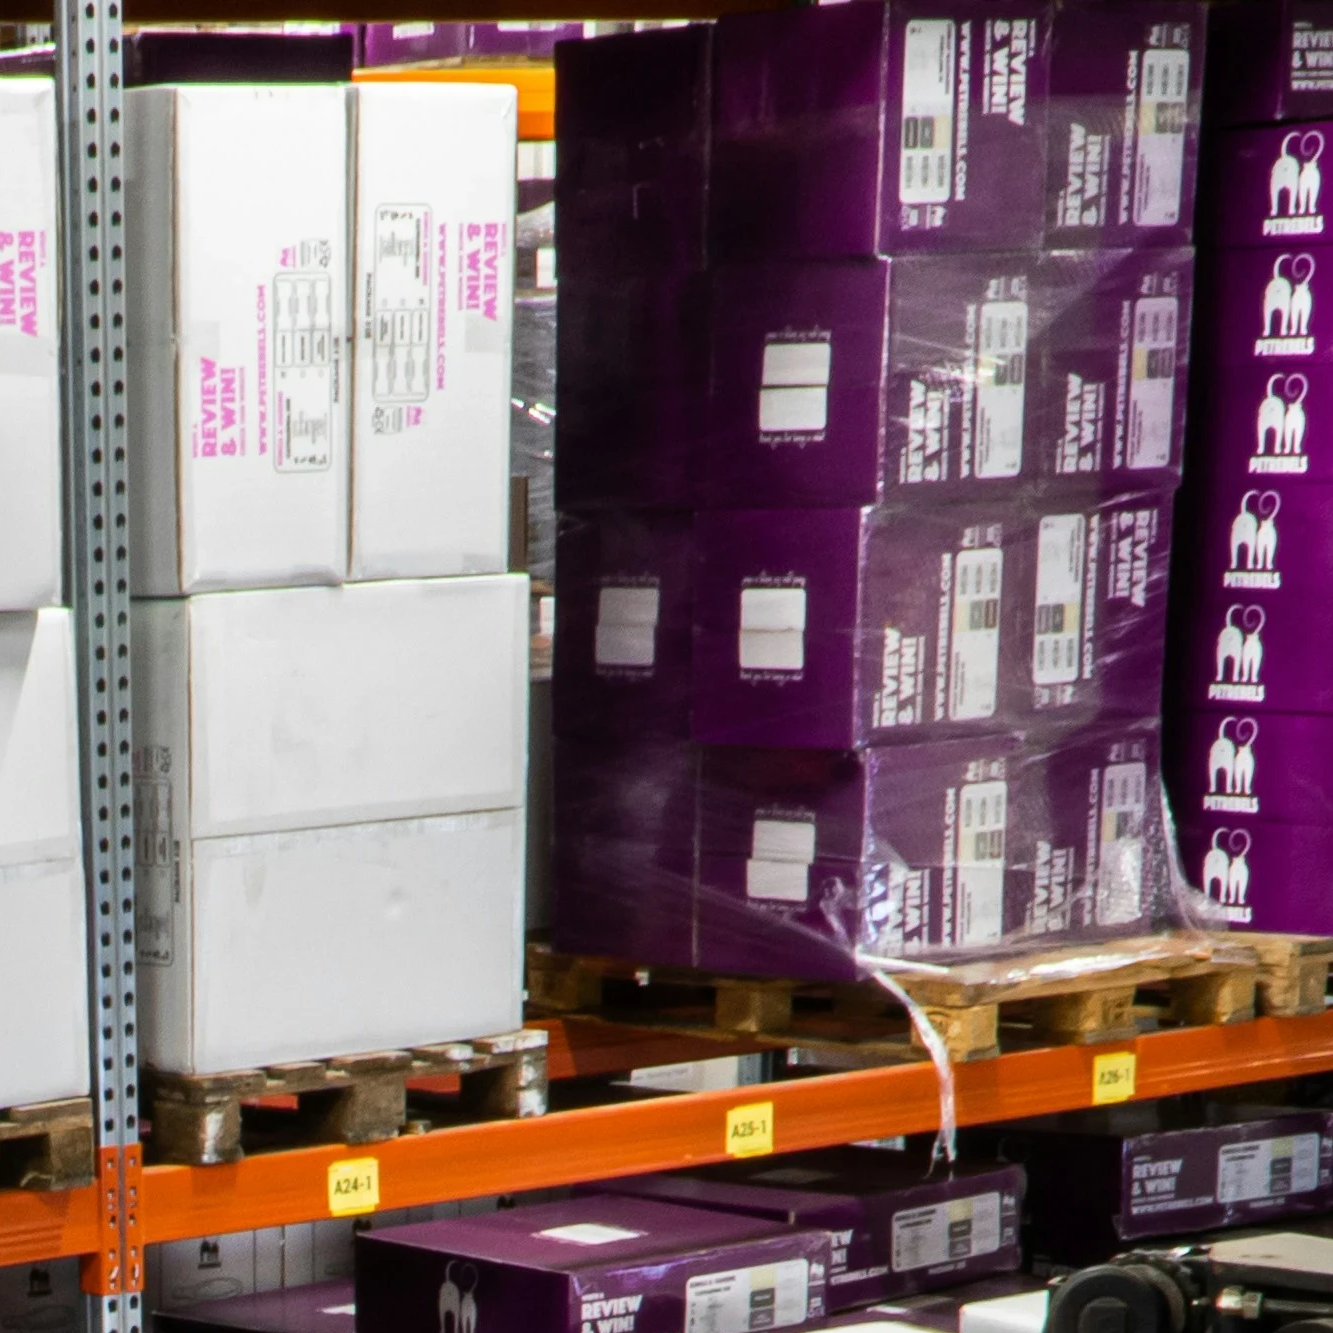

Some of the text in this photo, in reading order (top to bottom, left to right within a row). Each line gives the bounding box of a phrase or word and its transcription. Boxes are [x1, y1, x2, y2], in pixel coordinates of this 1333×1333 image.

[18, 231, 38, 336] REVIEW
[466, 223, 481, 309] & WIN!
[484, 223, 498, 320] REVIEW
[201, 357, 217, 457] REVIEW
[220, 368, 237, 456] & WIN!
[731, 1120, 767, 1140] A25-1
[334, 1175, 371, 1194] A24-1
[581, 1294, 643, 1321] REVIEW
